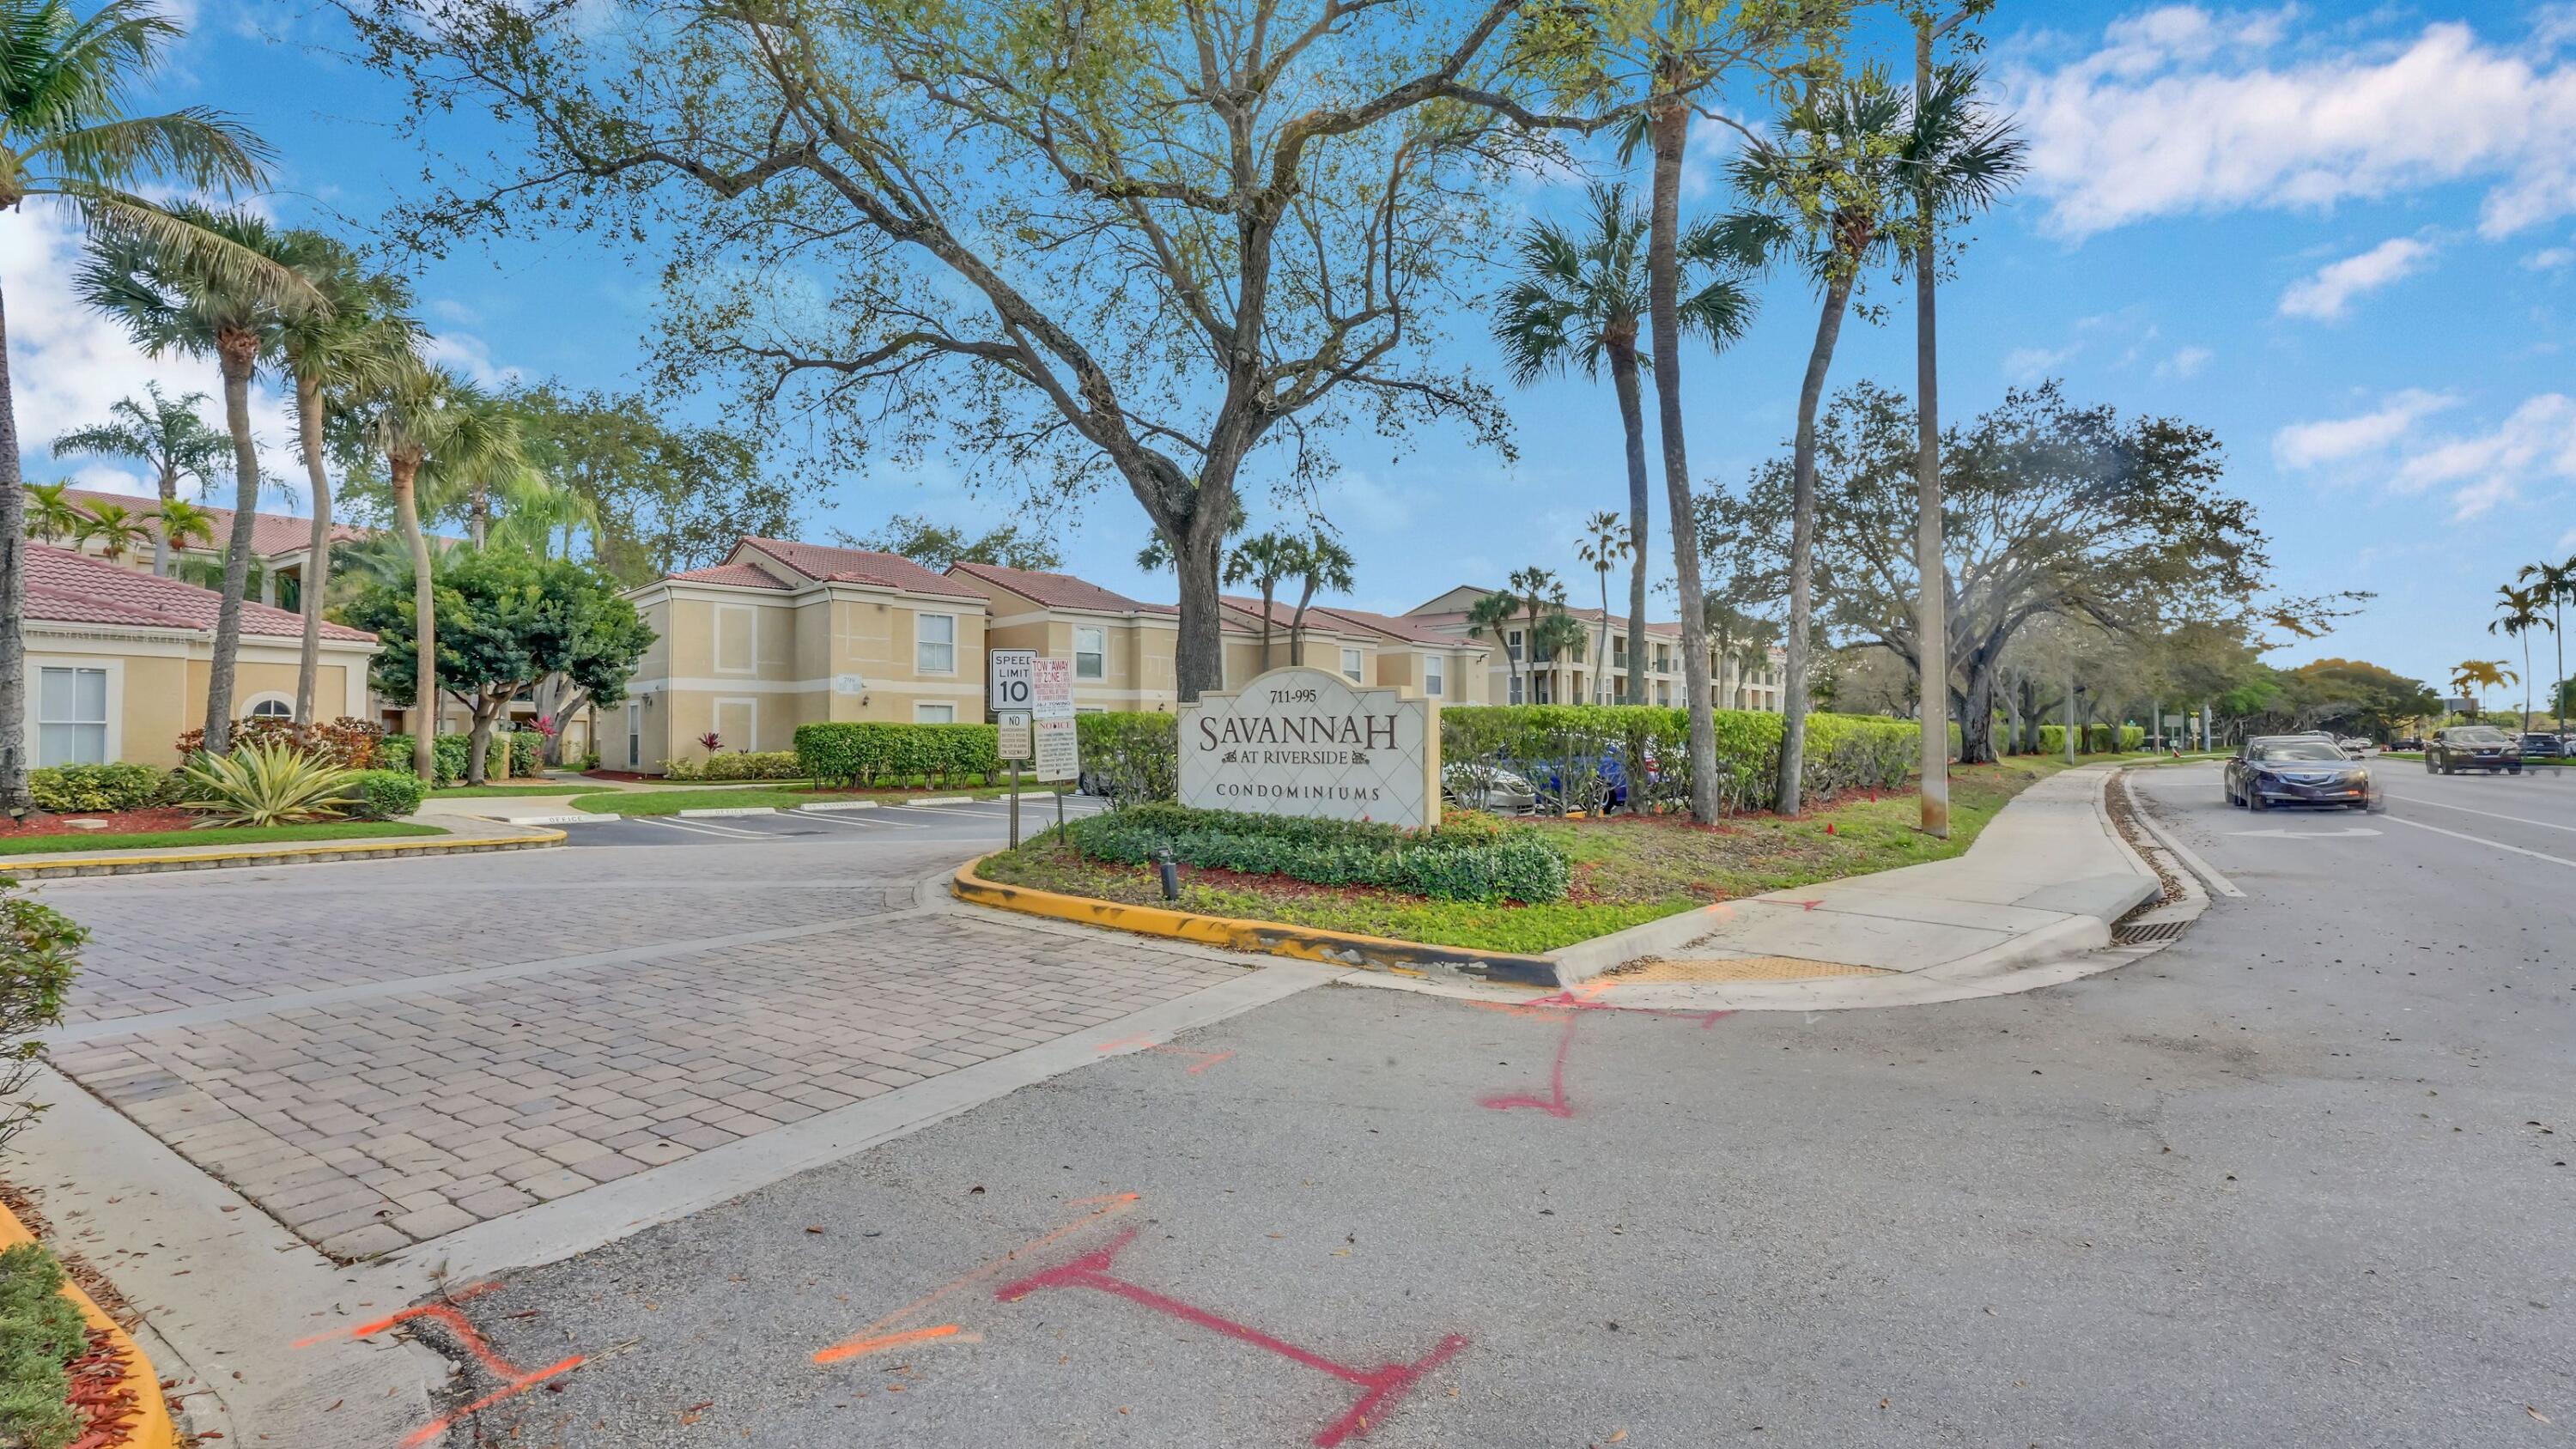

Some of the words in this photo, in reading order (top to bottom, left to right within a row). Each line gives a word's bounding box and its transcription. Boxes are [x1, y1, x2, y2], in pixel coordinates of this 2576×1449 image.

[1032, 660, 1048, 671] TOW
[1052, 660, 1069, 671] AWAY
[1043, 672, 1060, 682] ZONE
[1000, 681, 1029, 702] 10
[1270, 689, 1316, 704] 711-995
[1009, 716, 1020, 726] NO
[1200, 715, 1399, 752] SAVANNAH
[1241, 751, 1259, 764] AT
[1263, 751, 1348, 765] RIVERSIDE
[1216, 783, 1380, 801] CONDOMINIUMS
[550, 815, 585, 824] OFFICE
